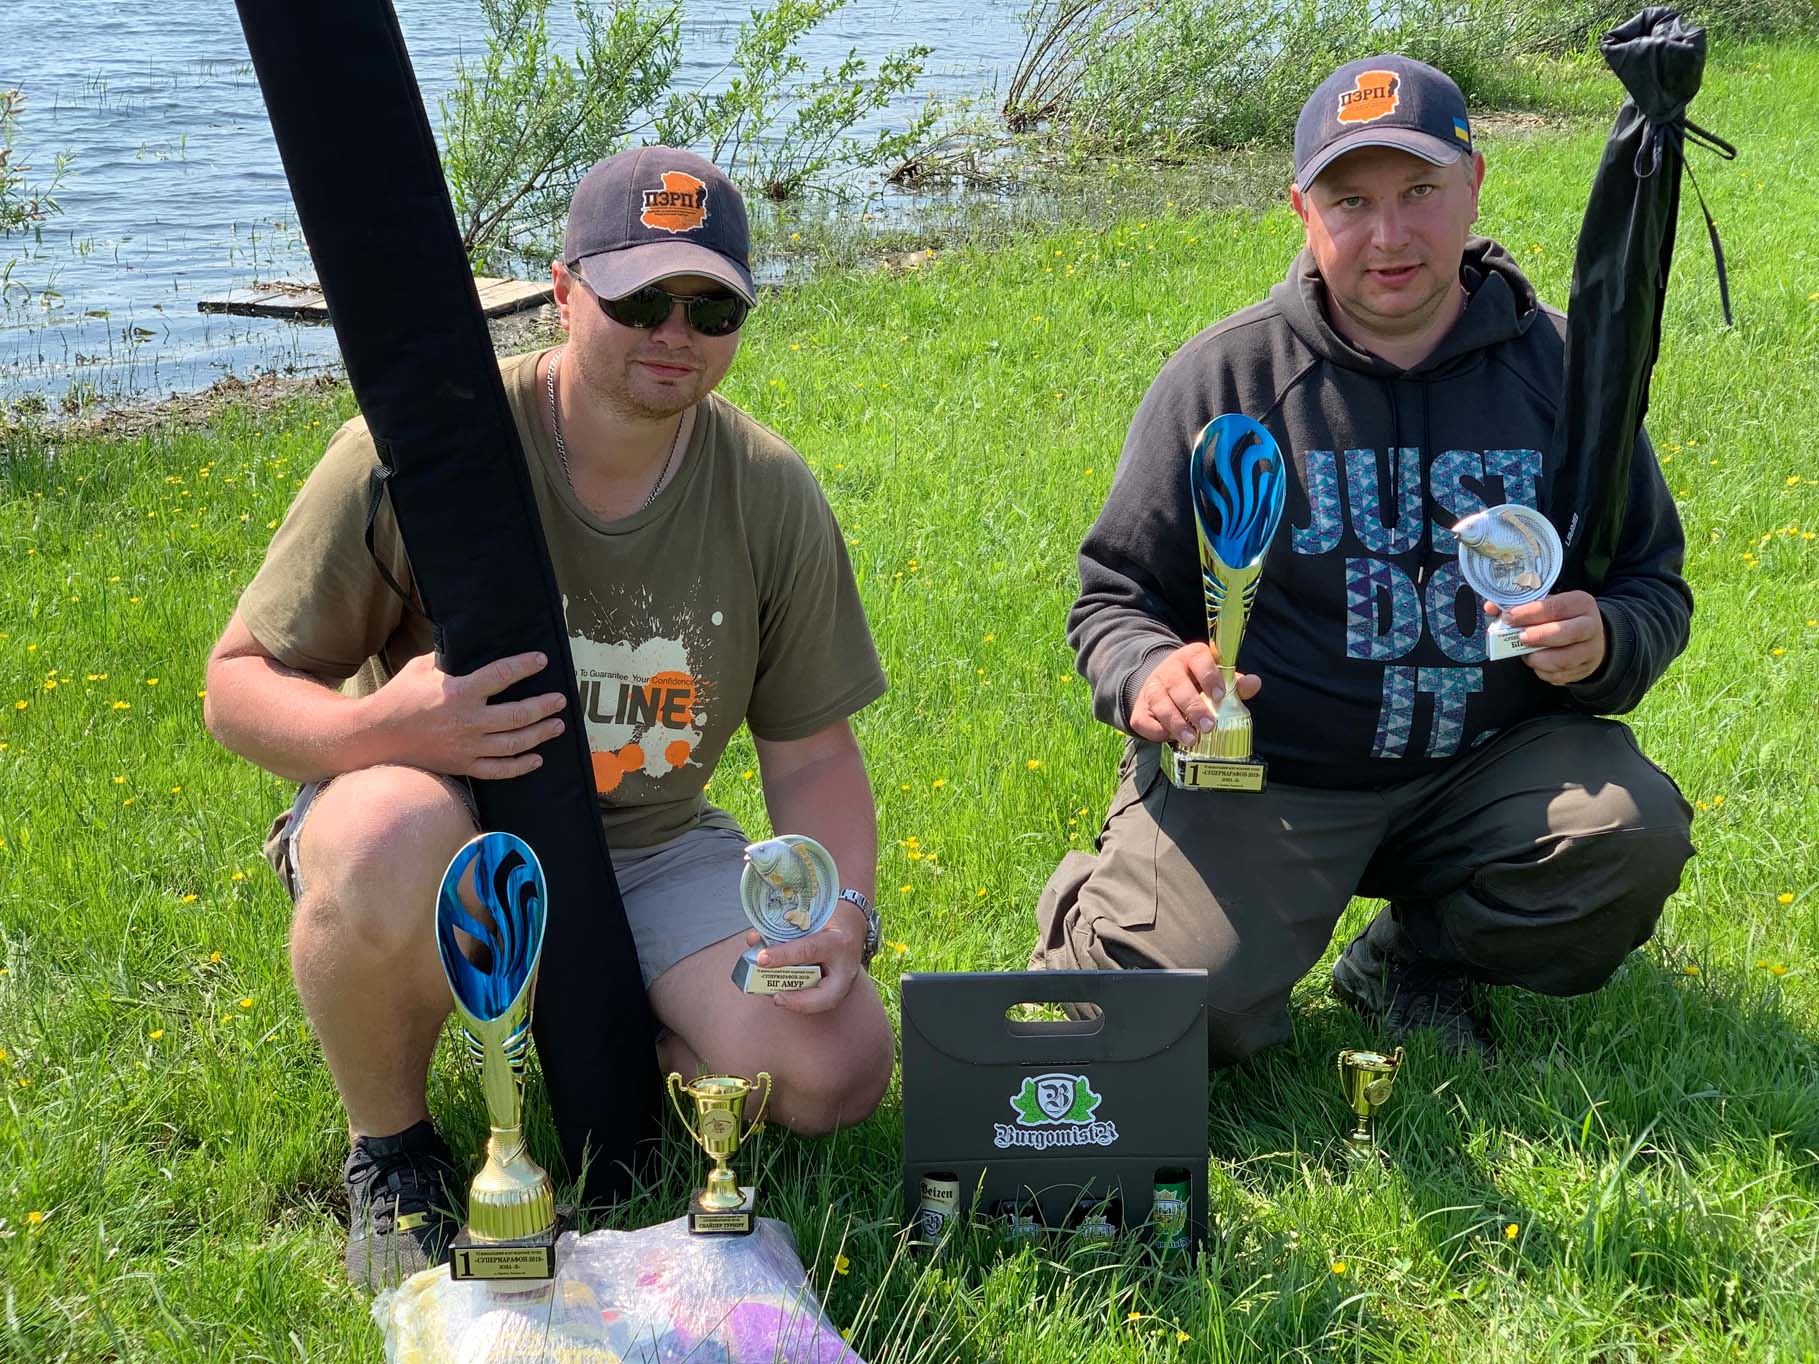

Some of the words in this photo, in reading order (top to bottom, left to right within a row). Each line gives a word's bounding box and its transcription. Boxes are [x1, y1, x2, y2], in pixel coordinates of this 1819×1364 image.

[1292, 447, 1543, 555] JUST
[1345, 557, 1491, 663] DO
[580, 669, 588, 677] To
[589, 670, 629, 681] Guarantee
[632, 674, 650, 683] Your
[767, 980, 780, 988] БІГ
[781, 980, 804, 988] АМУР
[459, 1251, 475, 1277] 1
